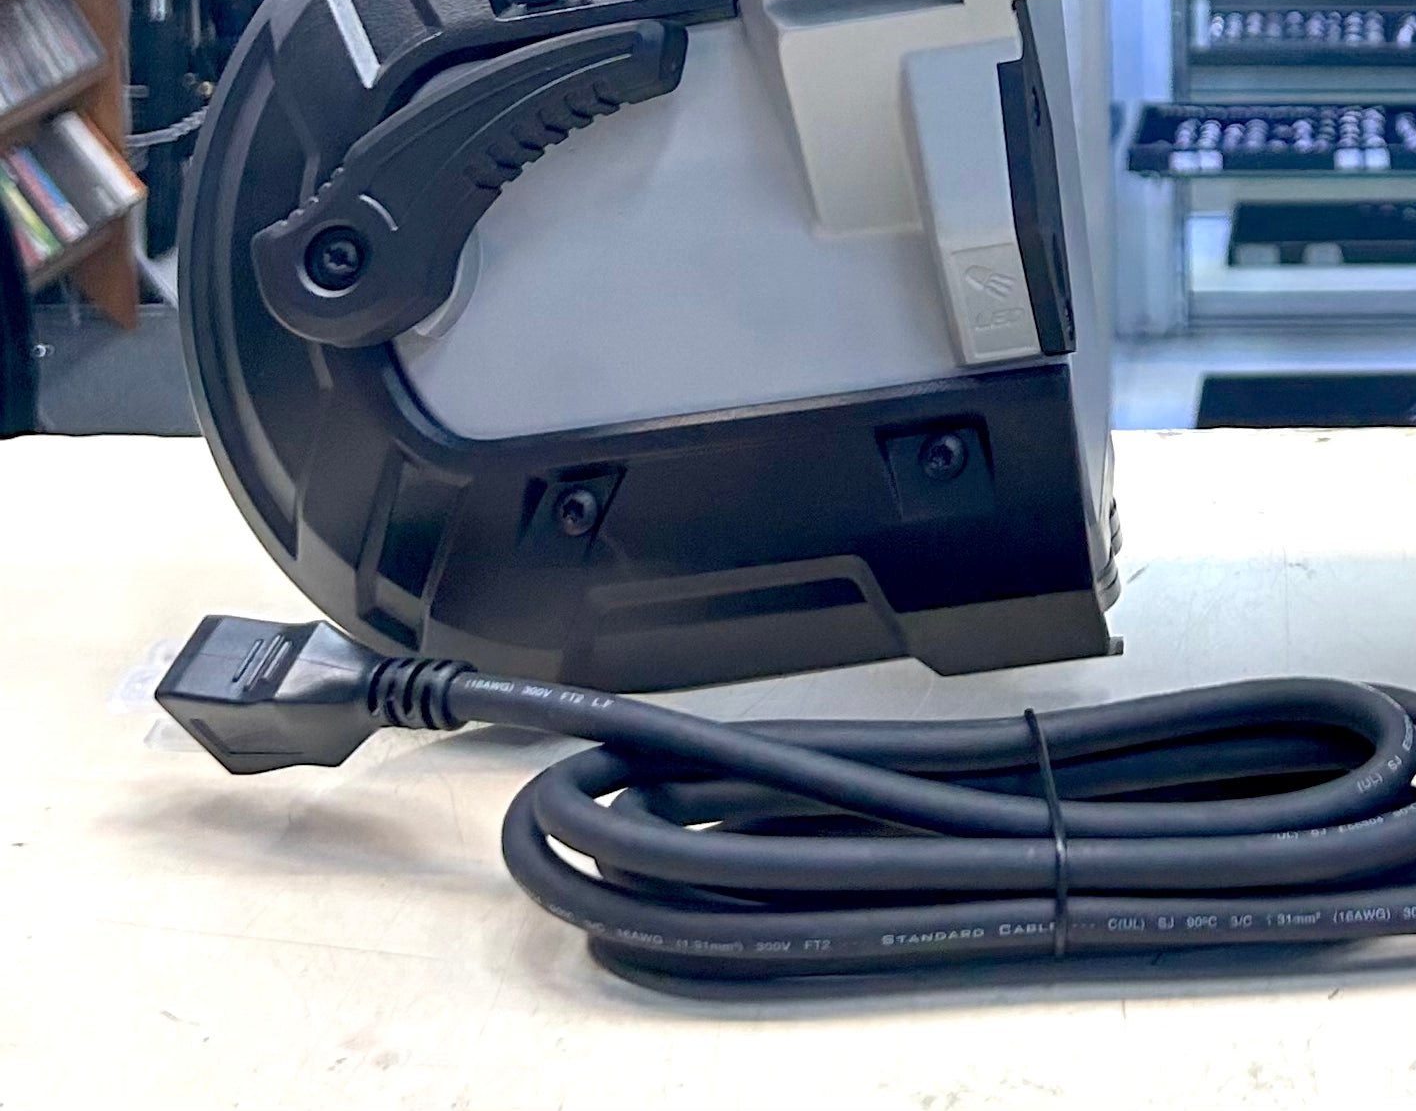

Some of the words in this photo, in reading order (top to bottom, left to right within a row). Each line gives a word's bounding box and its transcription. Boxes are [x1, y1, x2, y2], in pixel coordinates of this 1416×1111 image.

[881, 927, 985, 946] STANDARD
[1108, 916, 1146, 931] C(UL)
[1158, 915, 1175, 929] SJ
